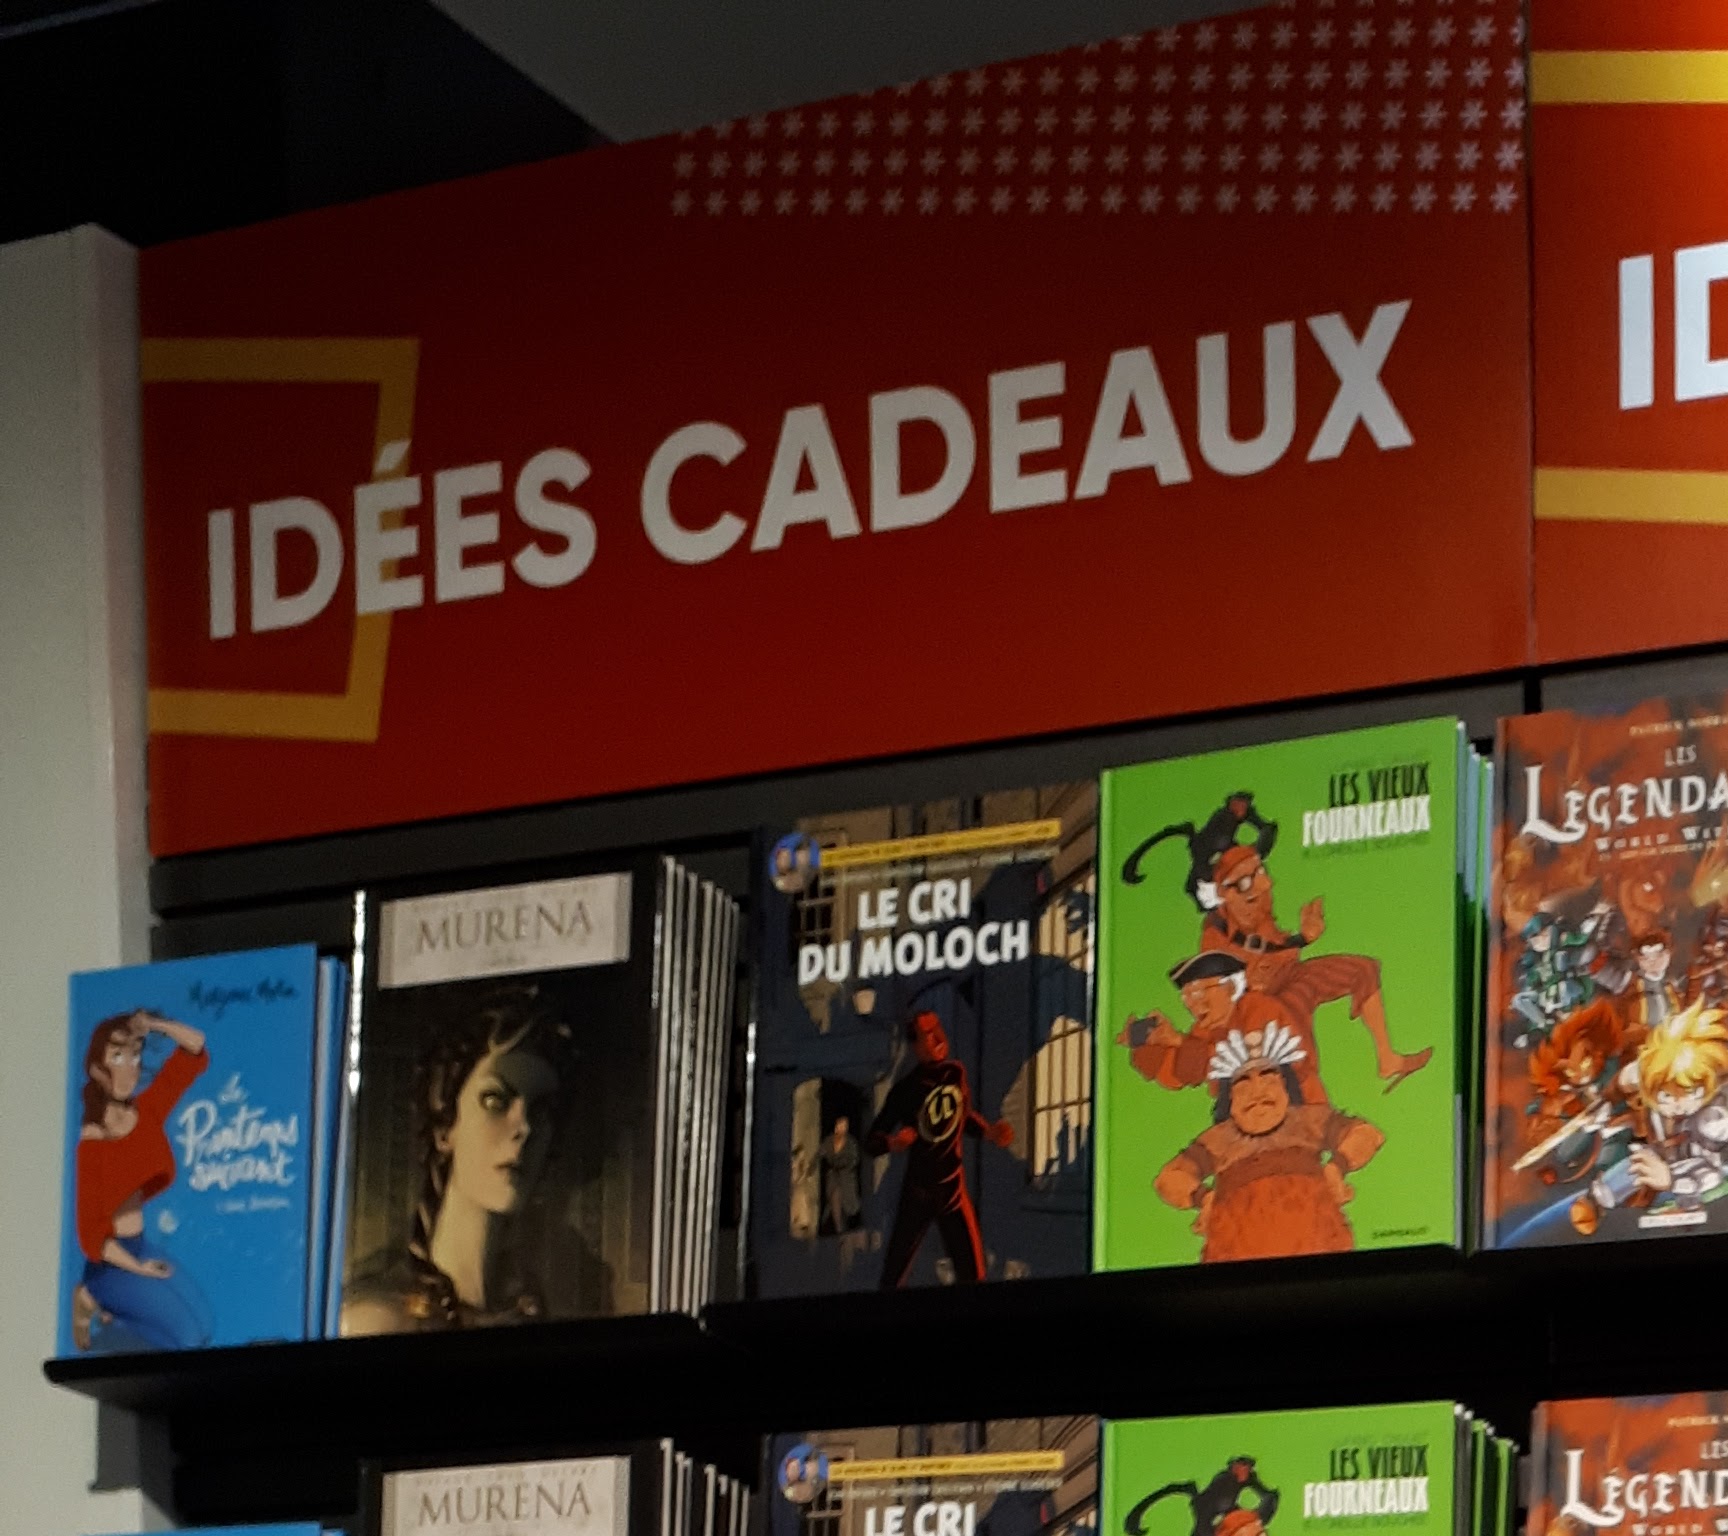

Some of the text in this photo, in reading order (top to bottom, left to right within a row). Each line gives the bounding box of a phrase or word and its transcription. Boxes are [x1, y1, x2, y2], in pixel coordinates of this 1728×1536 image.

[207, 300, 1414, 640] IDÉES CADEAUX
[1665, 745, 1697, 766] LES
[1328, 761, 1431, 803] LES VIEUX
[1302, 796, 1431, 847] FOURNEAUX
[858, 878, 970, 932] LE CRI
[416, 906, 593, 957] MURENA
[798, 920, 1030, 985] DU MOLOCH
[1329, 1444, 1428, 1480] LES VIEUX
[417, 1479, 591, 1529] MURENA
[1304, 1476, 1429, 1518] FOURNEAUX
